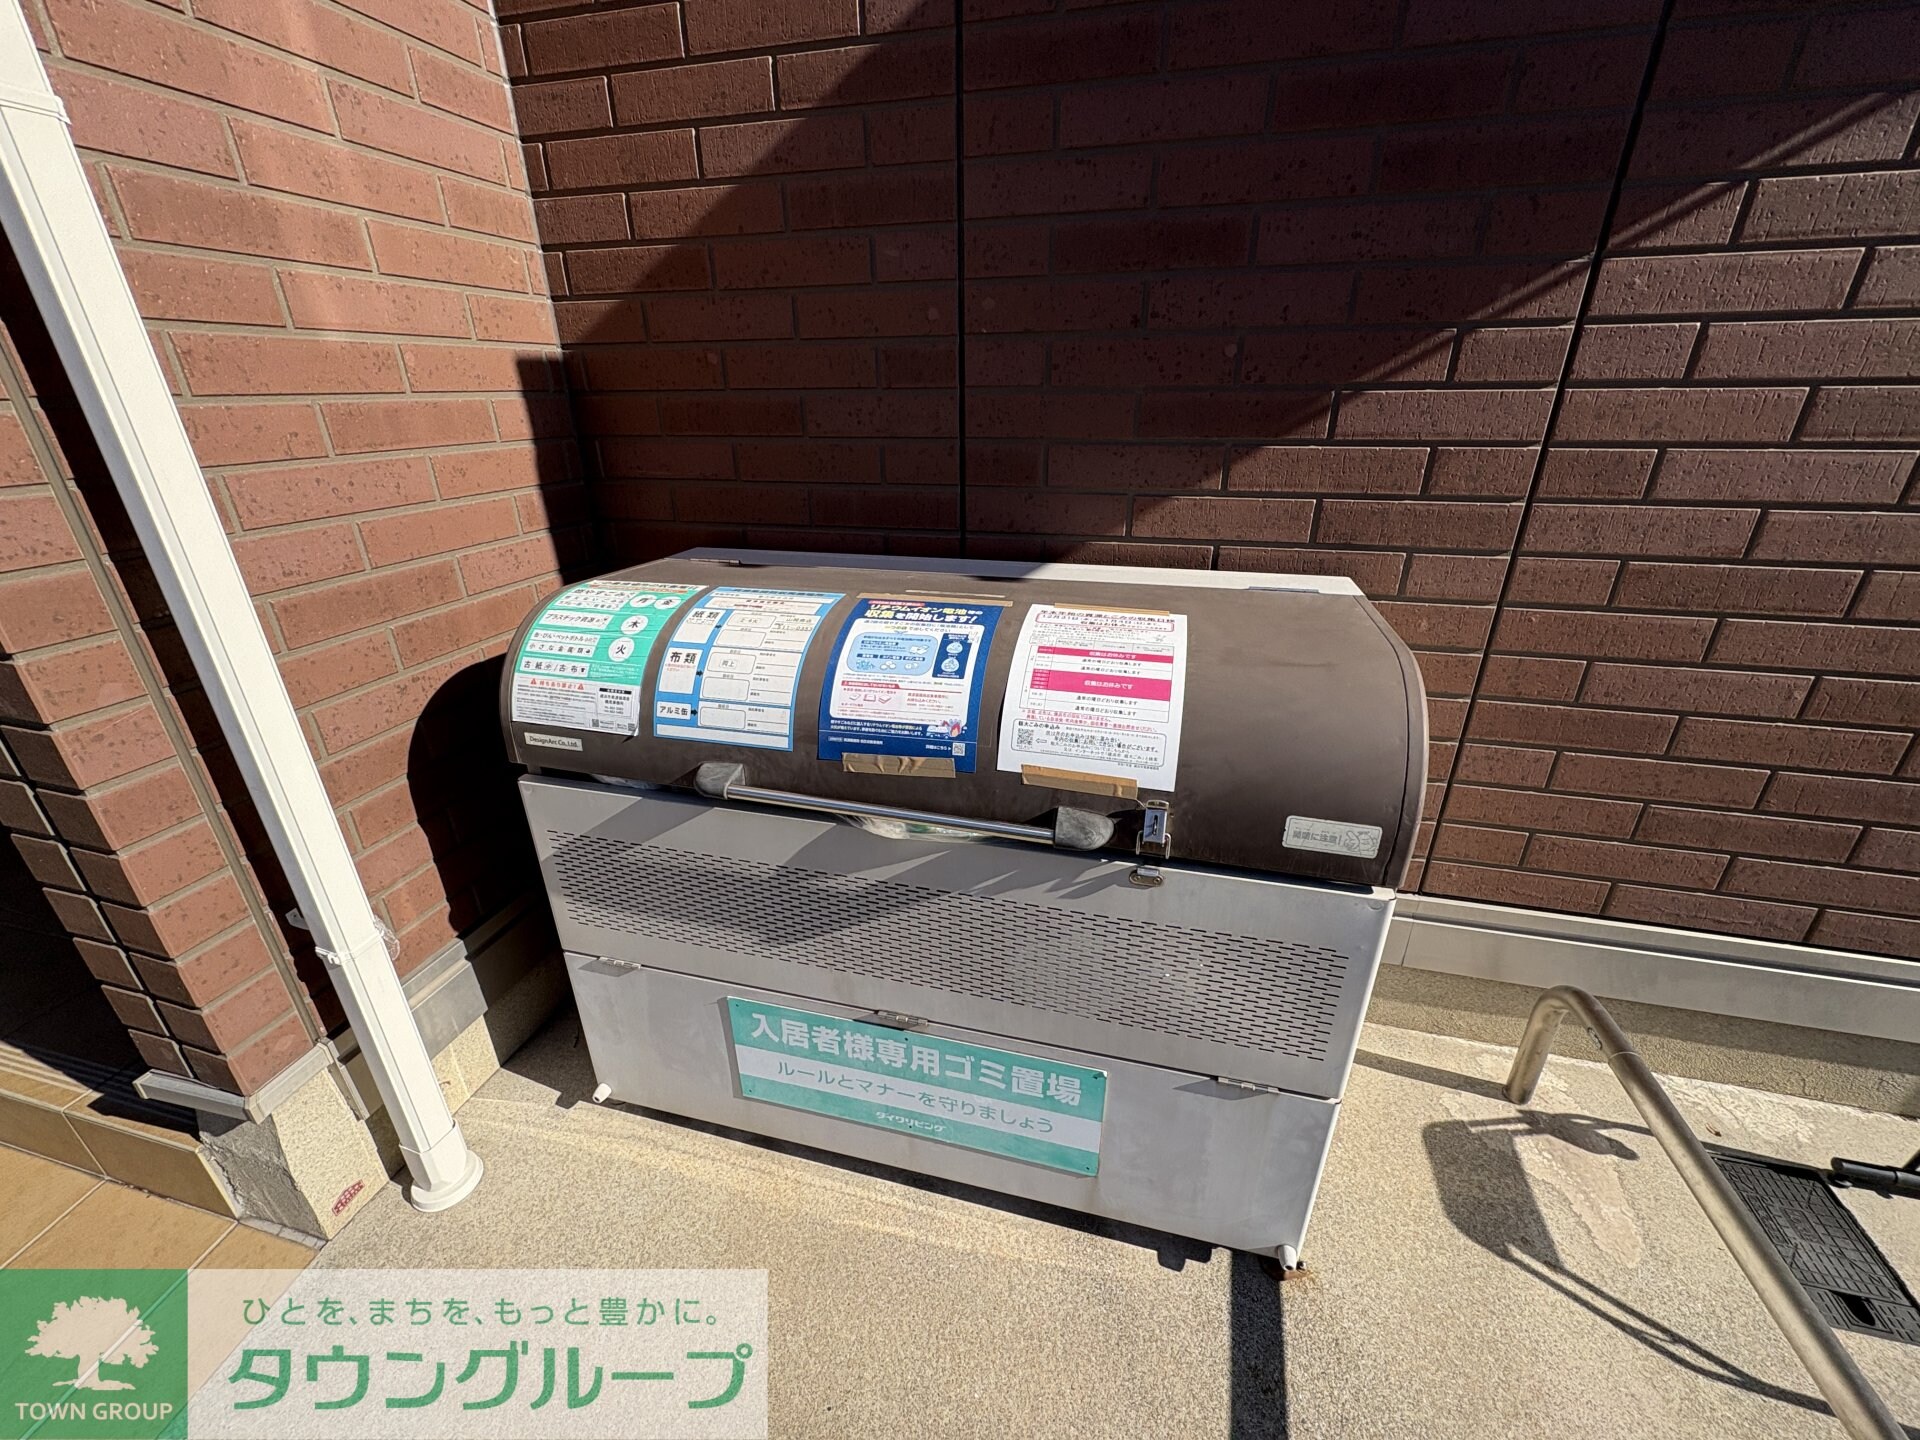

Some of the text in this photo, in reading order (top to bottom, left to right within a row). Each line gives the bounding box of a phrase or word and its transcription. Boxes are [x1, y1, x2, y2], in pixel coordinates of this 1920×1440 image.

[692, 610, 720, 619] 紙類
[616, 644, 626, 655] 火
[670, 651, 697, 664] 布類
[659, 705, 688, 716] アルミ缶
[752, 1012, 1083, 1107] 入居者様専用ゴミ置場
[777, 1060, 1054, 1134] ルールとマナーを守りましょう
